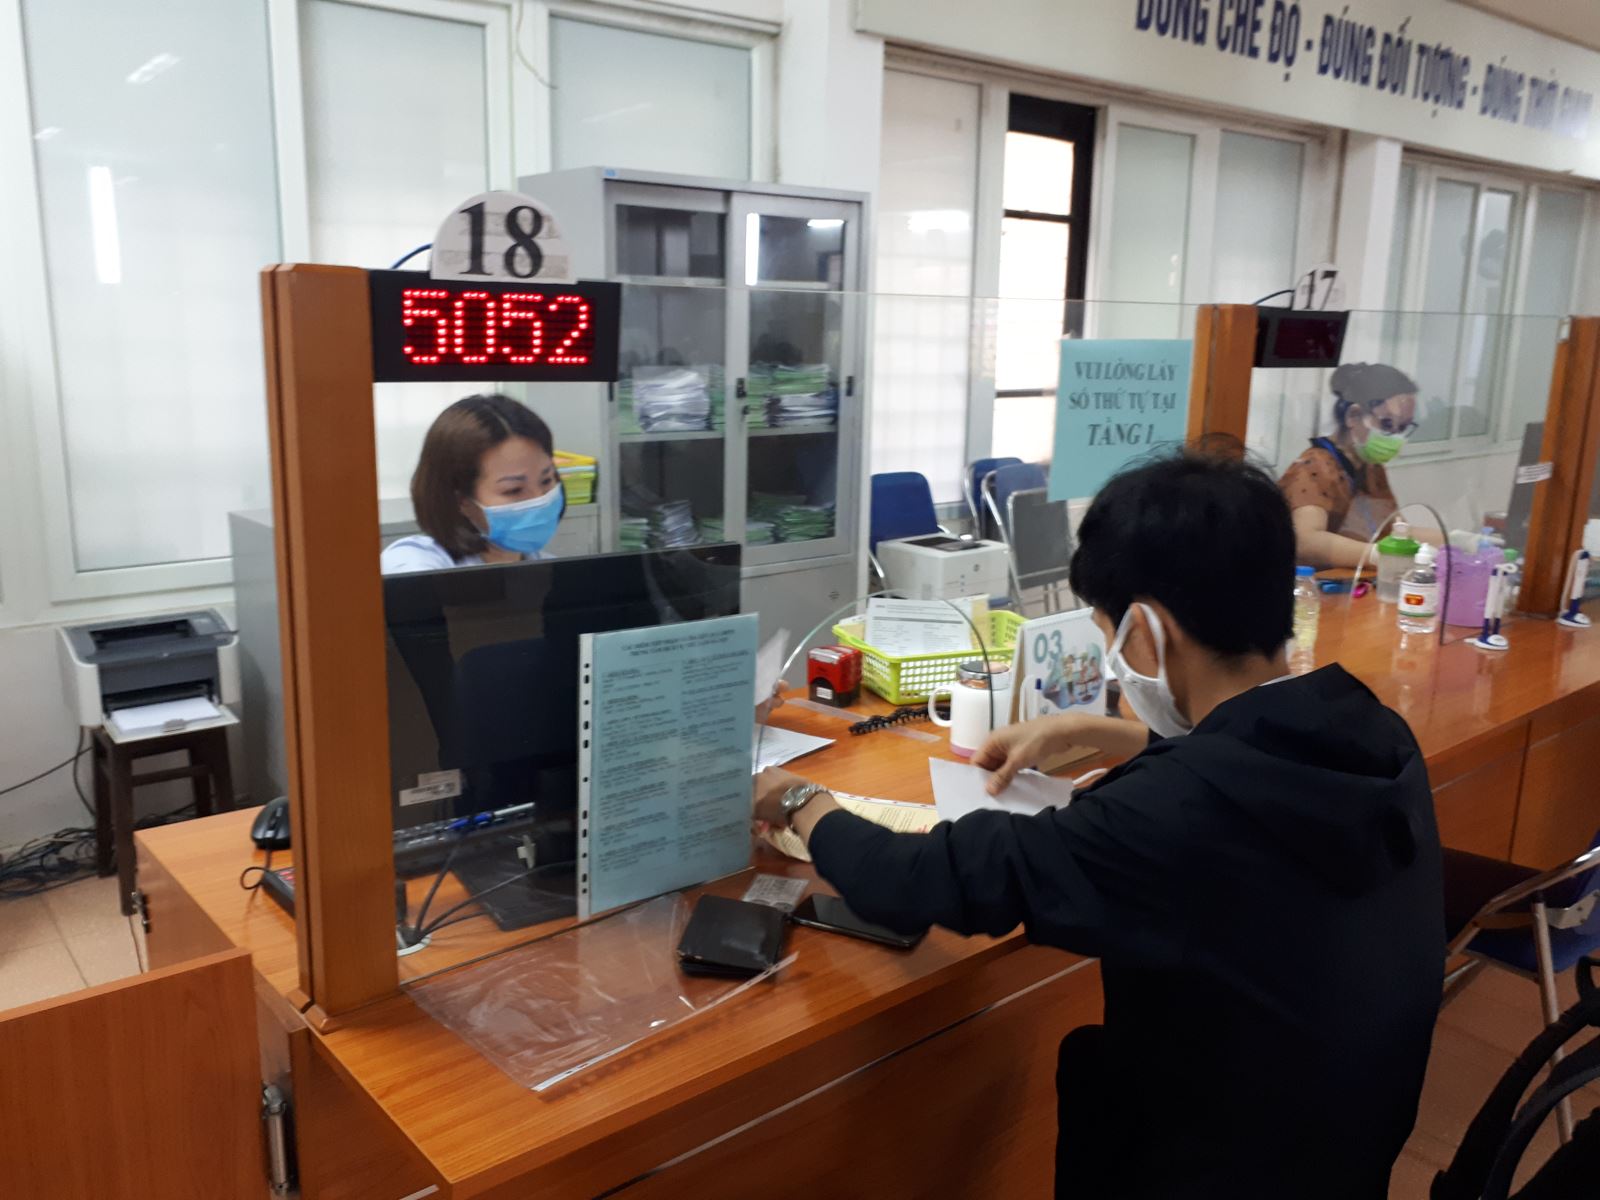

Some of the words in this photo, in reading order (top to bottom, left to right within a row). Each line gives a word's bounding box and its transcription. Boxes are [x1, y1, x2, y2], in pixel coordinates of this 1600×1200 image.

[1317, 5, 1376, 86] ĐÚNG
[458, 201, 543, 279] 18
[1304, 269, 1338, 310] 17
[403, 288, 588, 364] 5052
[1075, 362, 1102, 380] VUI
[1152, 392, 1176, 413] TẠI
[1144, 423, 1154, 445] 1
[1033, 629, 1062, 664] 03
